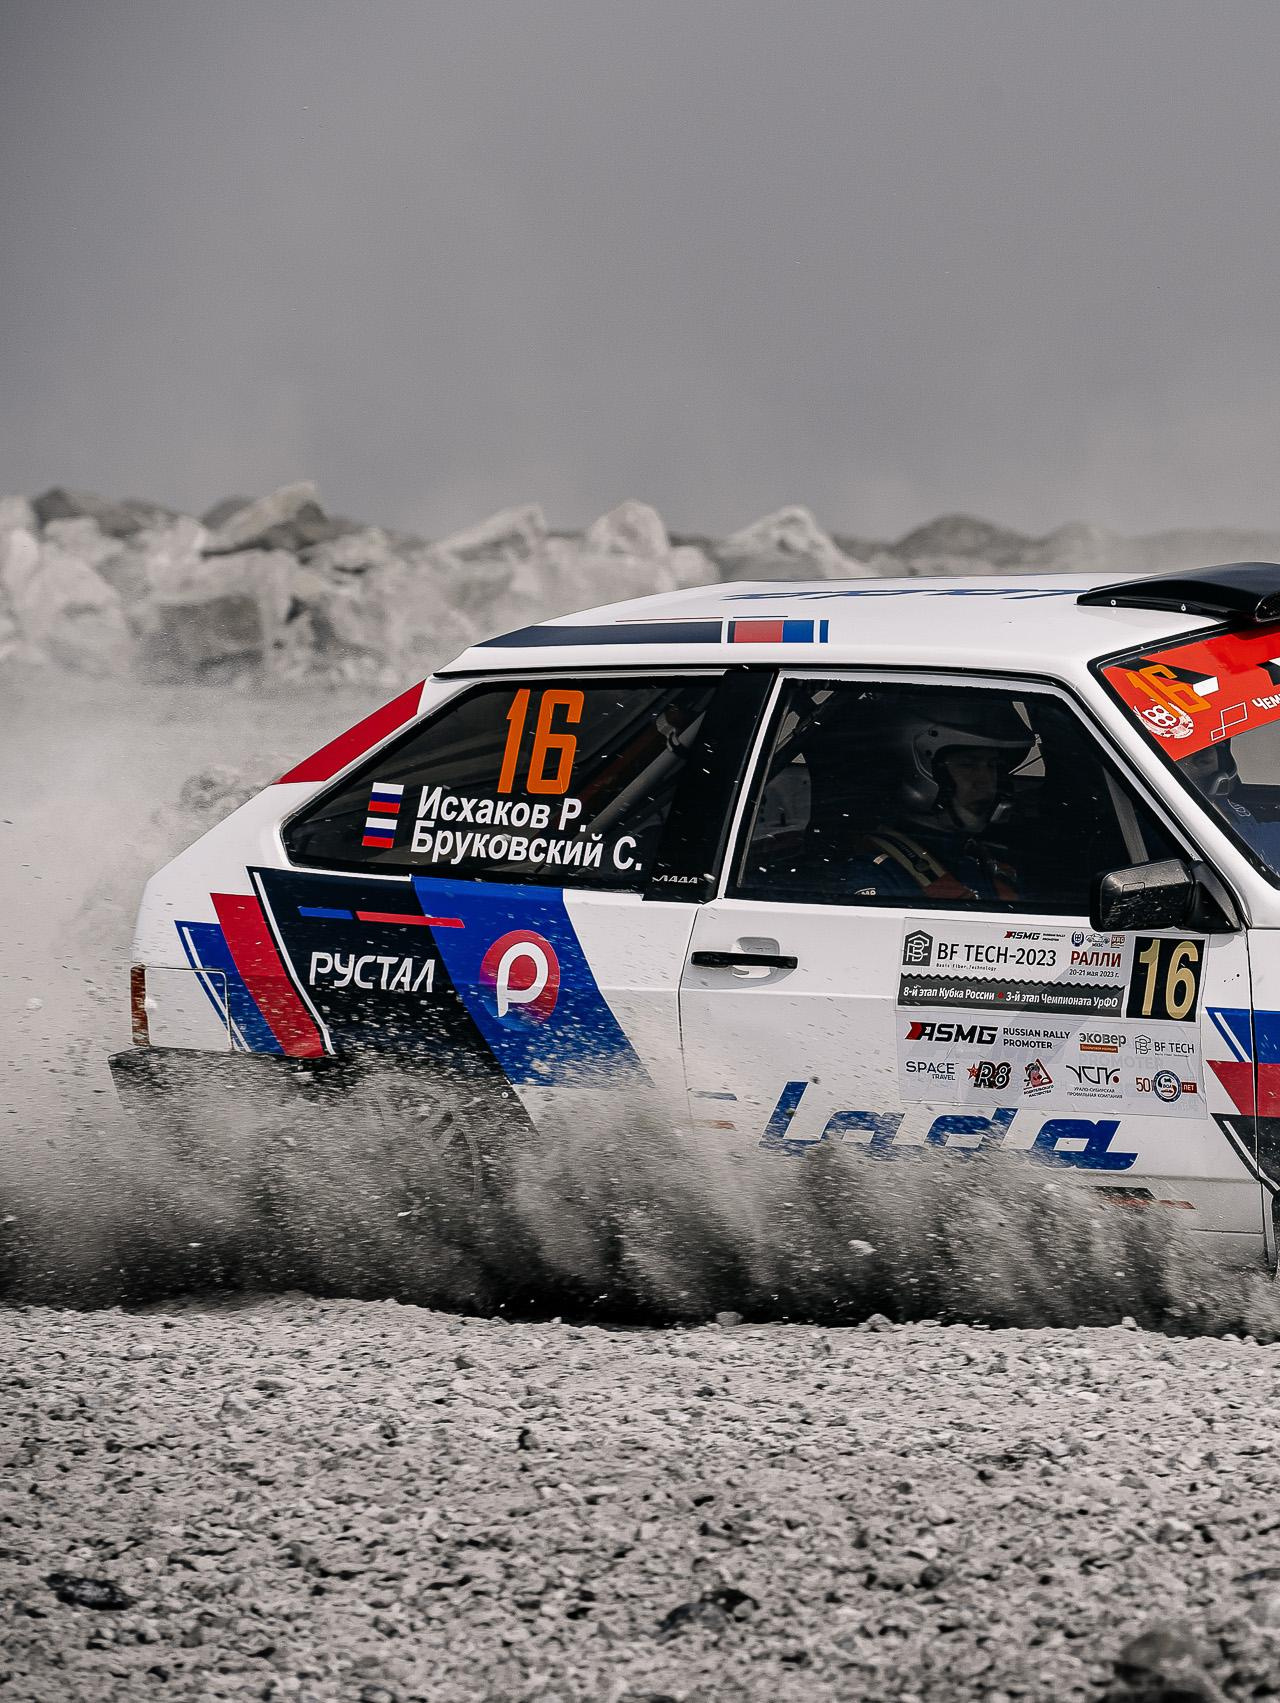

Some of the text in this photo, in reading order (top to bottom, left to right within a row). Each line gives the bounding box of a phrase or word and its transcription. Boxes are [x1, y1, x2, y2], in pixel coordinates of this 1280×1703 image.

[1125, 664, 1212, 718] 16
[497, 688, 585, 795] 16
[416, 785, 587, 832] Исхаков Р.
[410, 820, 643, 871] Бруковский С.
[1004, 931, 1041, 941] ASMG
[937, 942, 1057, 967] BF TECH-2023
[1070, 950, 1122, 968] РАЛЛИ
[309, 951, 436, 993] РУСТАЛ
[1099, 970, 1115, 978] 2023
[1139, 938, 1199, 1021] 16
[903, 984, 995, 1001] 8-й этап Кубка России
[1005, 990, 1119, 1010] 3-й этап Чемпионата УрФО
[906, 1021, 999, 1045] ASMG
[1002, 1027, 1071, 1040] RUSSIAN RALLY
[1003, 1038, 1053, 1050] PROMOTER
[1154, 1041, 1195, 1054] BF TECH
[905, 1060, 956, 1075] SPACE
[1135, 1077, 1151, 1093] 50
